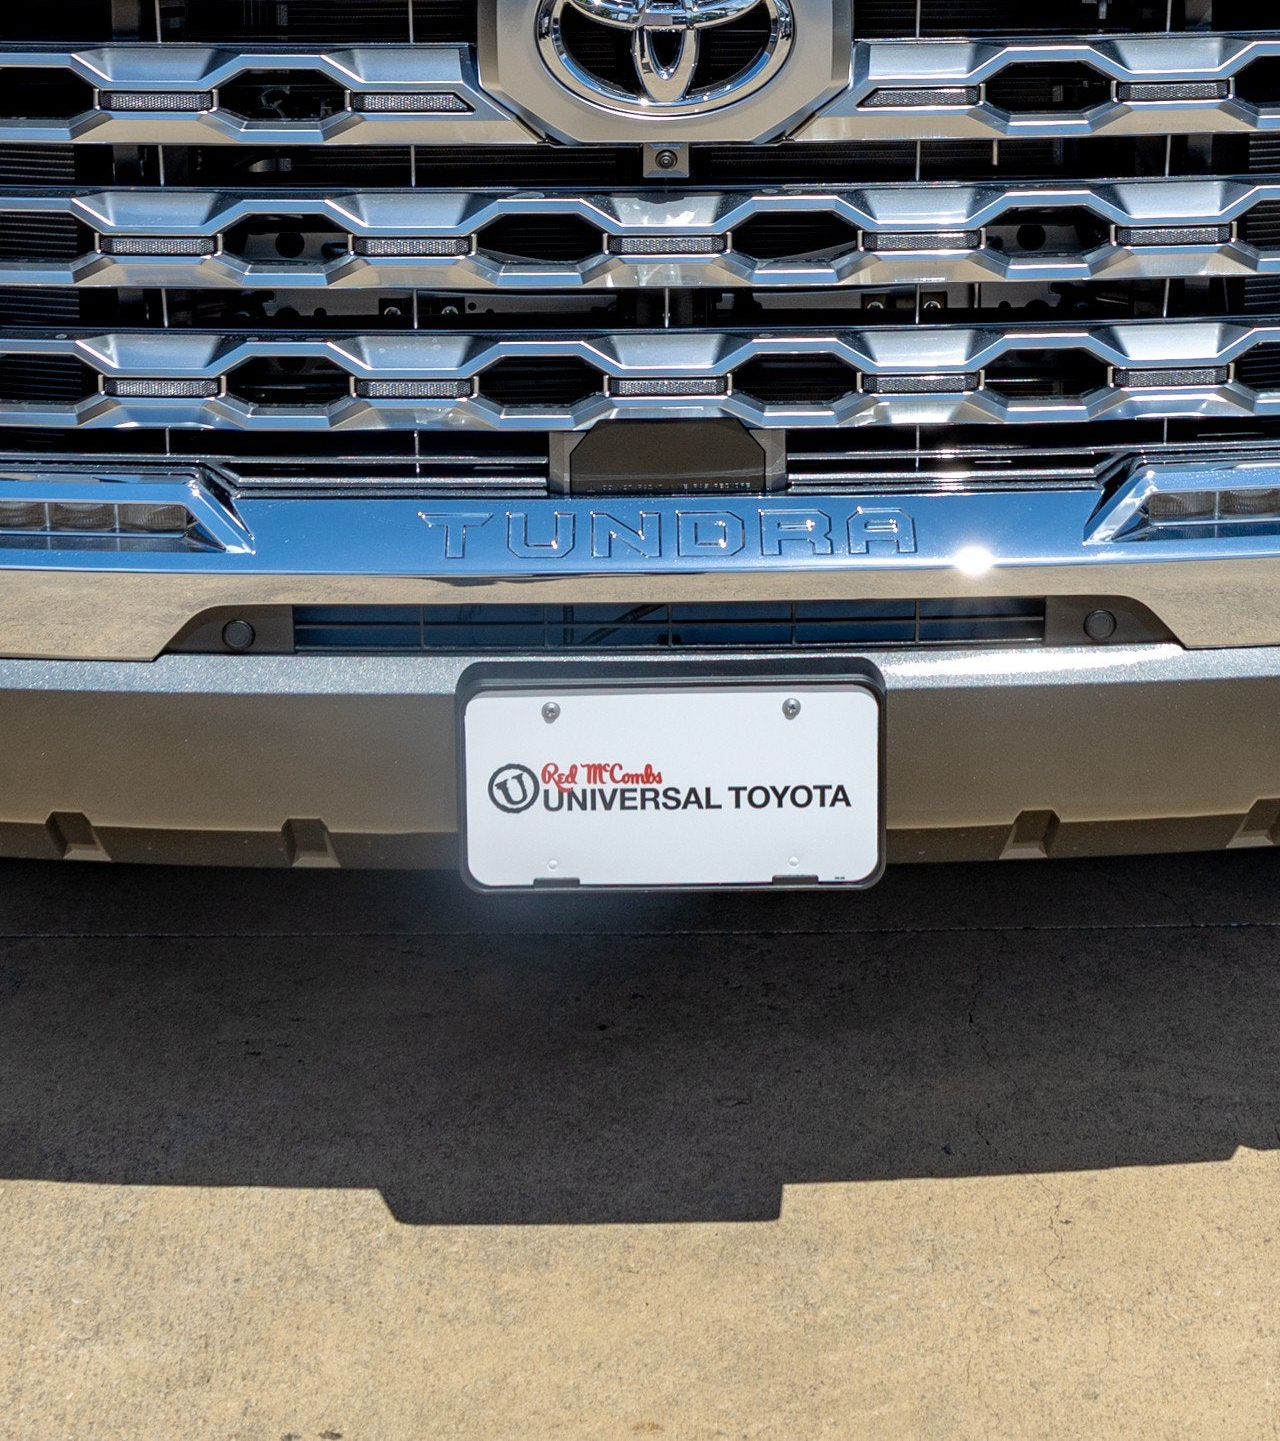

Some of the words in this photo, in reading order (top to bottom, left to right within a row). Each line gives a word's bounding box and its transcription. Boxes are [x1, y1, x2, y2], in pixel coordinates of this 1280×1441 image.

[419, 506, 918, 559] TUNDRA
[541, 762, 577, 792] Red
[543, 785, 723, 812] UNIVERSAL
[728, 784, 852, 810] TOYOTA
